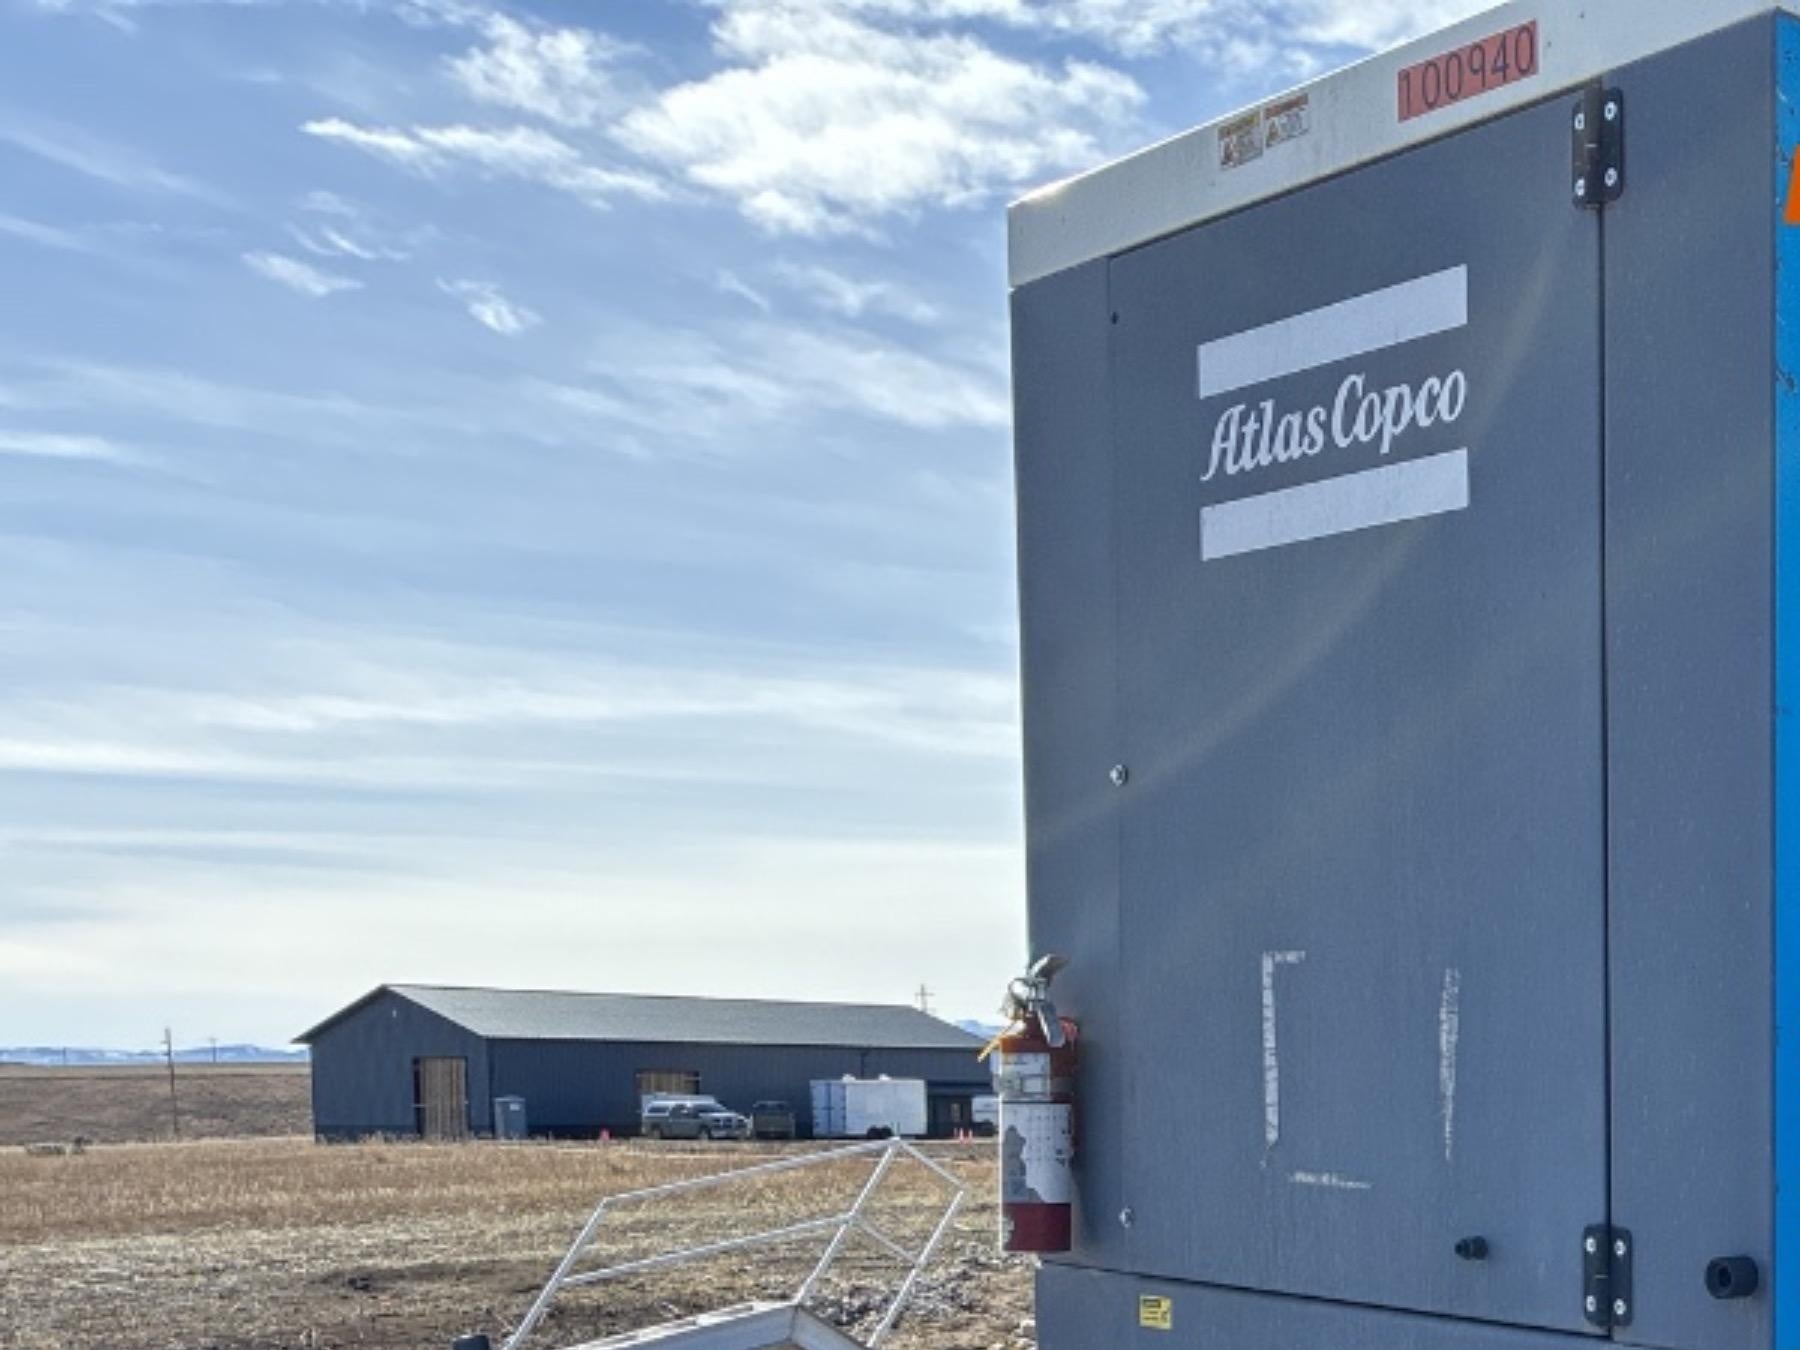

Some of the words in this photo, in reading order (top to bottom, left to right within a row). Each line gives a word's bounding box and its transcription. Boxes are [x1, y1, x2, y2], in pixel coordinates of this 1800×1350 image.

[1399, 24, 1533, 121] 100940
[1200, 399, 1327, 481] Atlas
[1331, 369, 1466, 454] Copco
